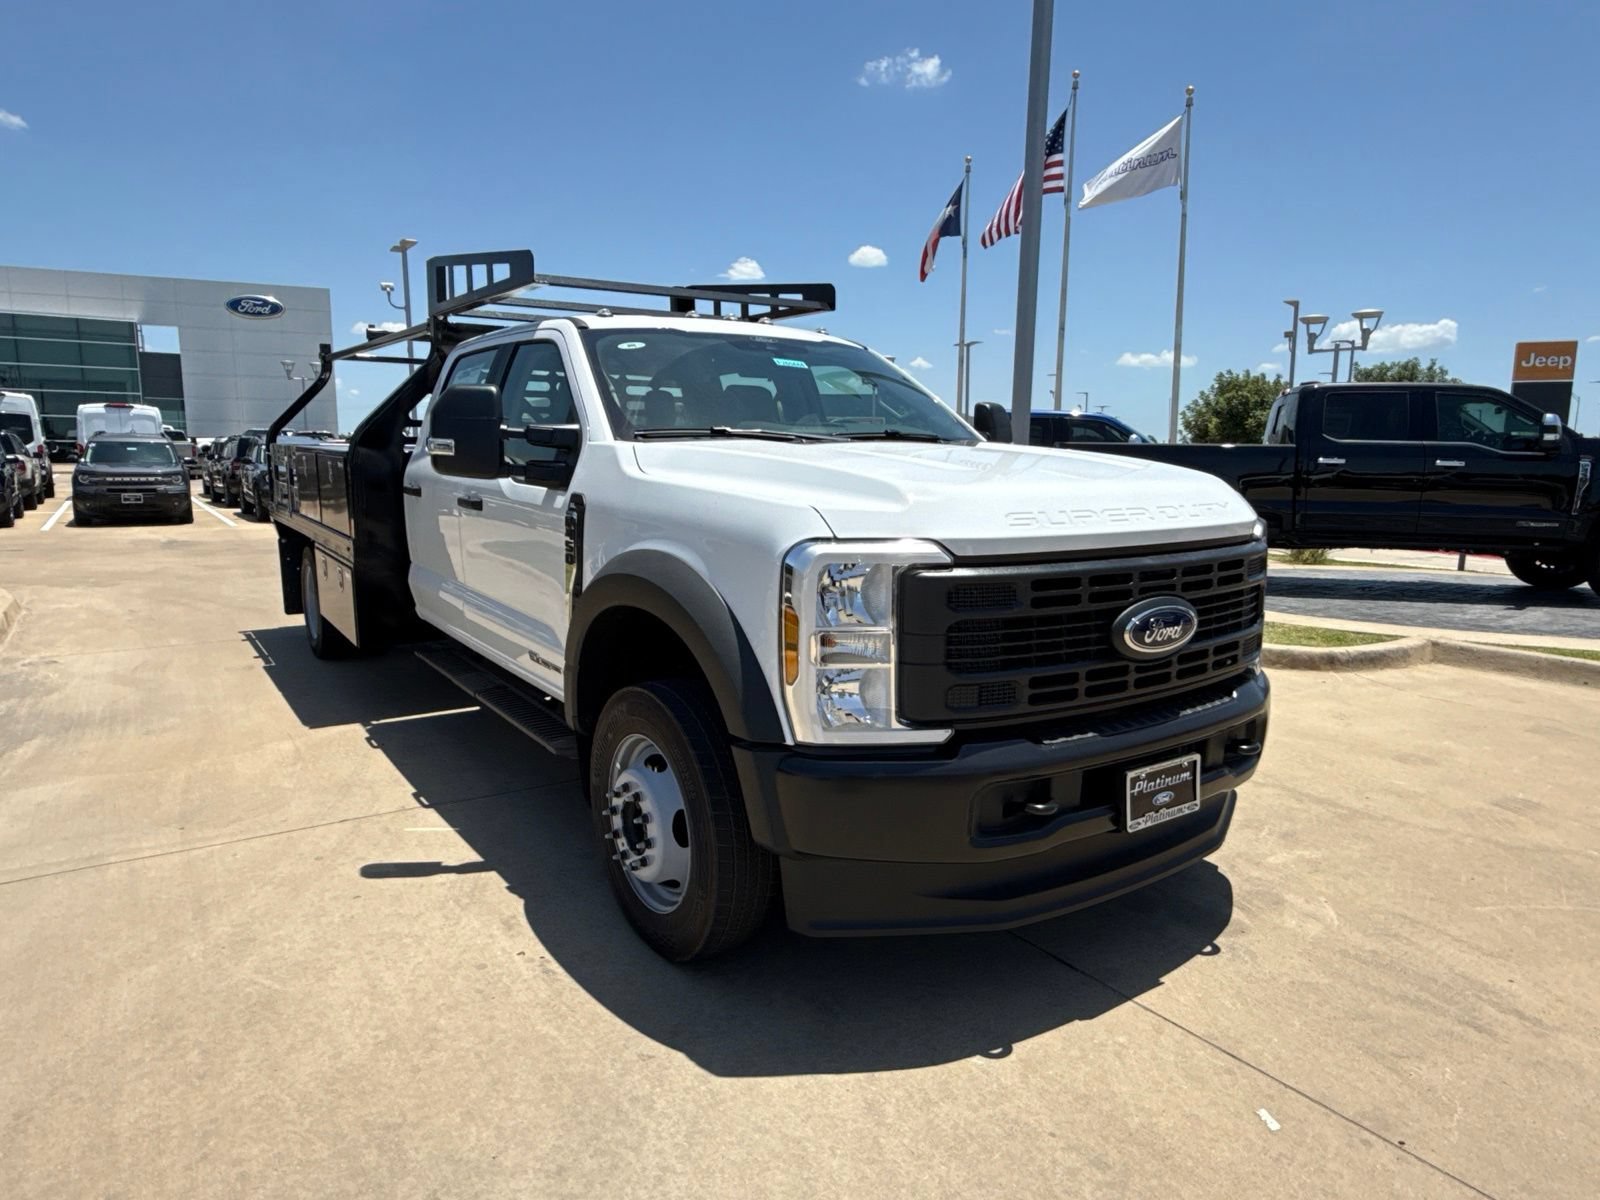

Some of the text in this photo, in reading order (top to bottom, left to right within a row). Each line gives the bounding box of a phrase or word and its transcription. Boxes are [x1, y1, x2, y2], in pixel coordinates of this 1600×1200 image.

[237, 299, 272, 314] Ford
[1520, 352, 1572, 369] Jeep
[1004, 501, 1229, 527] SUPER DUTY
[1144, 616, 1183, 643] Ford
[1130, 771, 1193, 796] Platinum
[1143, 807, 1186, 825] Platinum
